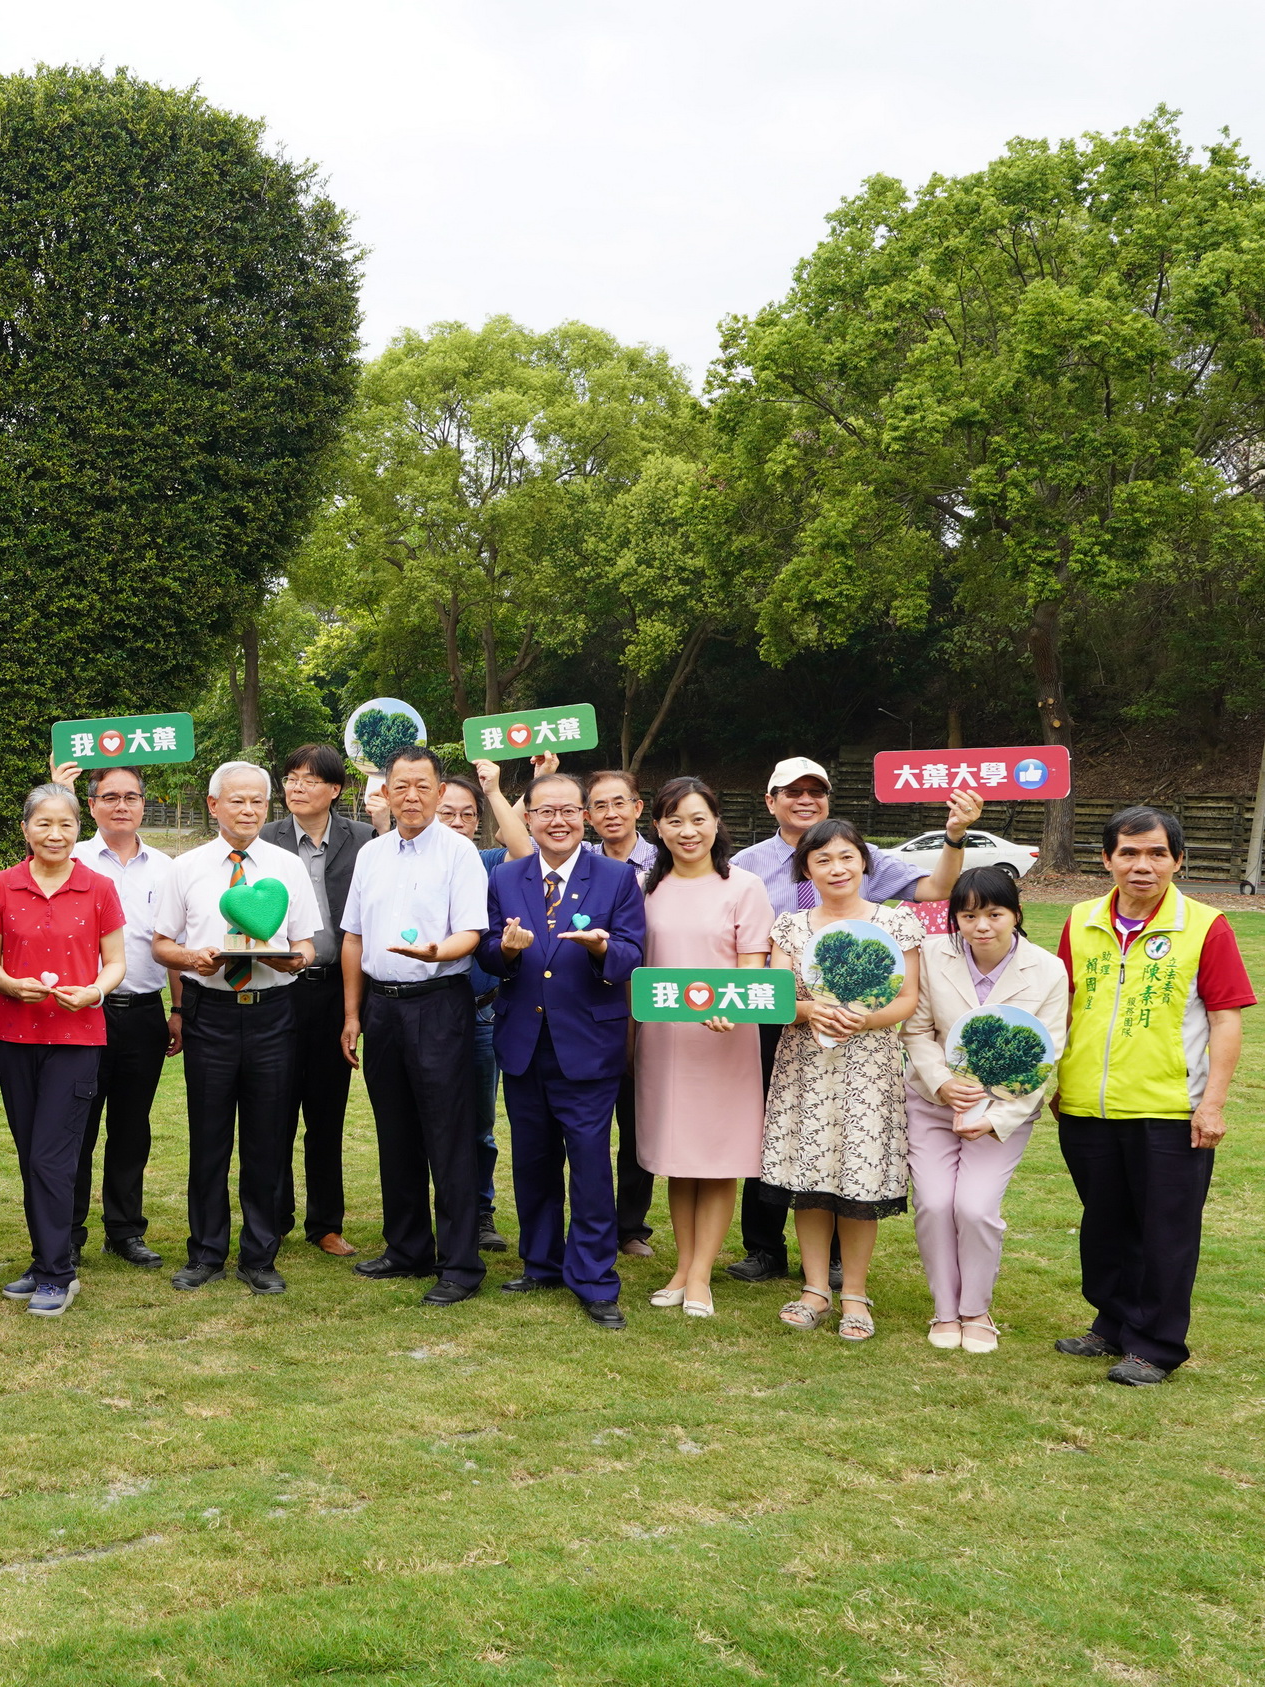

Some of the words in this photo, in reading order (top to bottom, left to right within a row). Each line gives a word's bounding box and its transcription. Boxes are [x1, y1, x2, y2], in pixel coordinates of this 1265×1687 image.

[71, 732, 95, 757] 我
[127, 726, 177, 753] 大葉
[480, 727, 504, 751] 我
[534, 717, 582, 744] 大葉
[893, 762, 1008, 790] 大葉大學
[652, 981, 680, 1009] 我
[717, 982, 775, 1010] 大葉
[1137, 962, 1162, 1029] 陳素月
